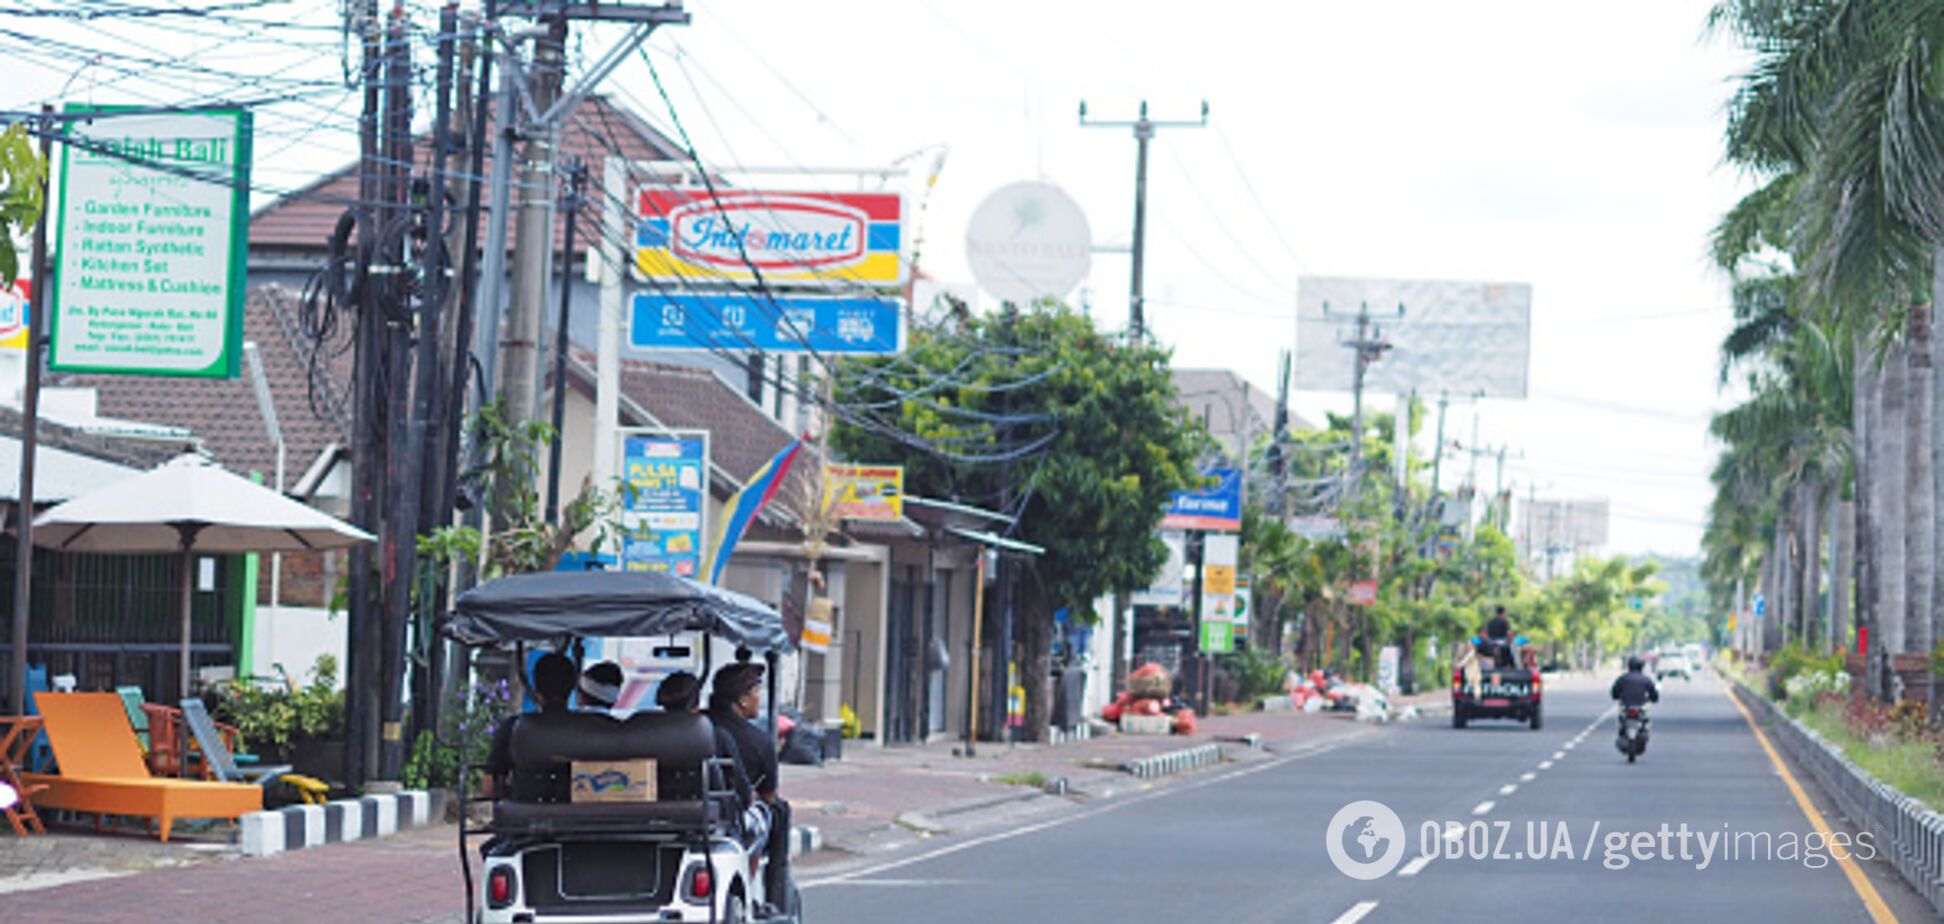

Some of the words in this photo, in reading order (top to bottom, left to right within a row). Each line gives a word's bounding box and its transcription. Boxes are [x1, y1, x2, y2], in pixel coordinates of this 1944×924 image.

[174, 136, 227, 162] Bali
[84, 200, 139, 214] Garden
[143, 203, 212, 217] Furniture
[83, 219, 131, 234] Indoor
[137, 220, 204, 236] Furniture
[692, 216, 852, 250] Indomaret
[81, 238, 131, 252] Rattan
[136, 239, 204, 255] Synthetic
[81, 257, 139, 272] Kitchen
[143, 259, 169, 273] Set
[81, 276, 145, 291] Mattress
[160, 278, 222, 293] Cushion
[630, 463, 677, 477] PULSA
